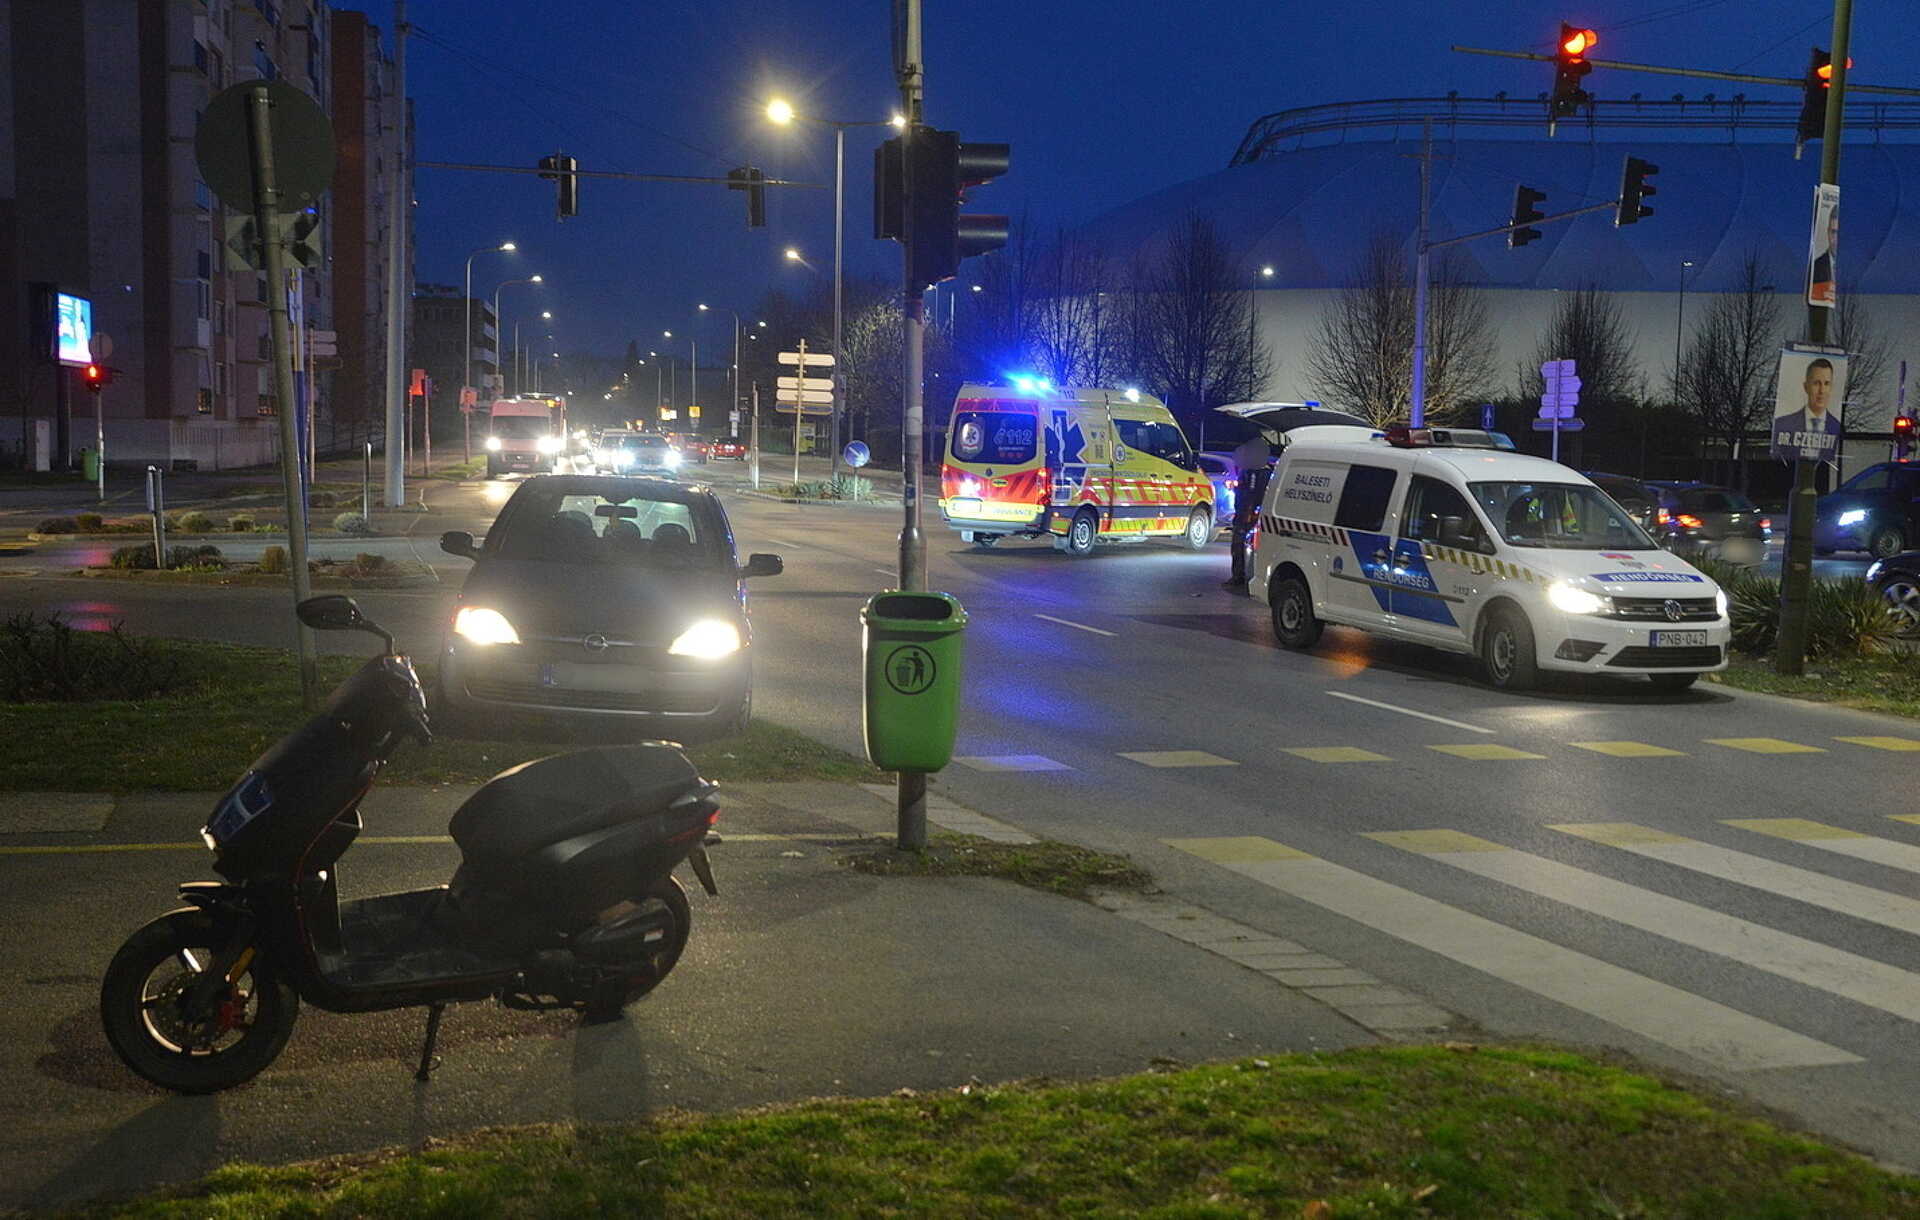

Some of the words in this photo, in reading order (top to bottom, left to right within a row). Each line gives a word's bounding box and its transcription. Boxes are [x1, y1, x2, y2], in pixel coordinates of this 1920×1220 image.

[1006, 429, 1032, 445] 112
[1777, 431, 1792, 446] DR.
[1294, 473, 1330, 488] BALESETI
